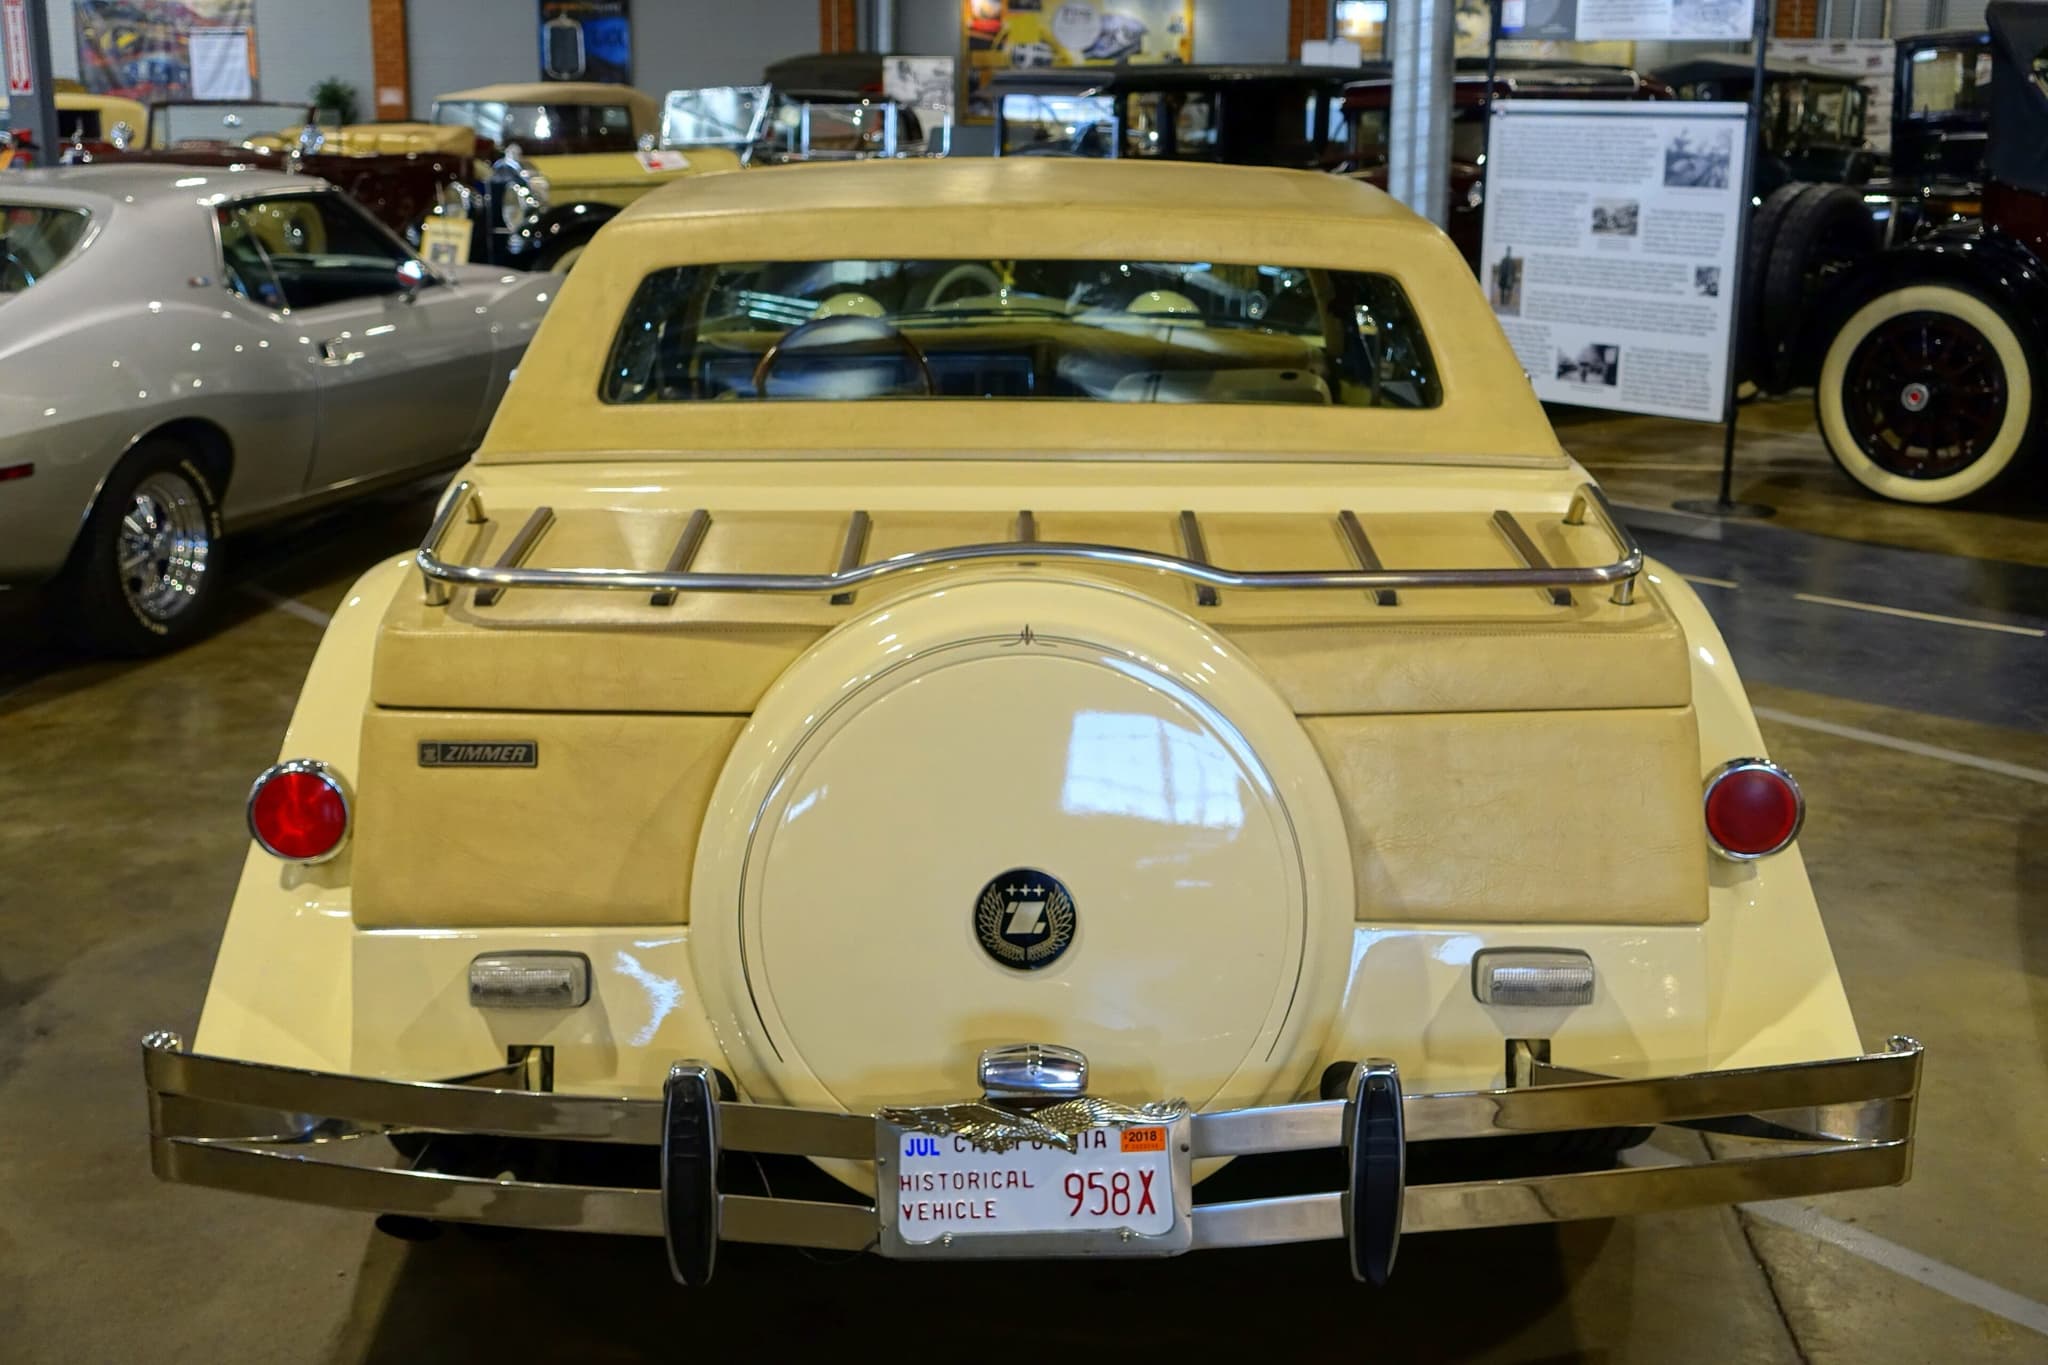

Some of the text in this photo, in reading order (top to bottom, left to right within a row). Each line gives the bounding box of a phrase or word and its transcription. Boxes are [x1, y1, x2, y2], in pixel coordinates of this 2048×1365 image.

[444, 745, 528, 761] ZIMMER
[1128, 1130, 1157, 1142] 2018
[905, 1138, 940, 1157] JUL
[900, 1170, 1035, 1192] HISTORICAL
[1063, 1169, 1156, 1217] 958X
[901, 1200, 998, 1221] VEHICLE
